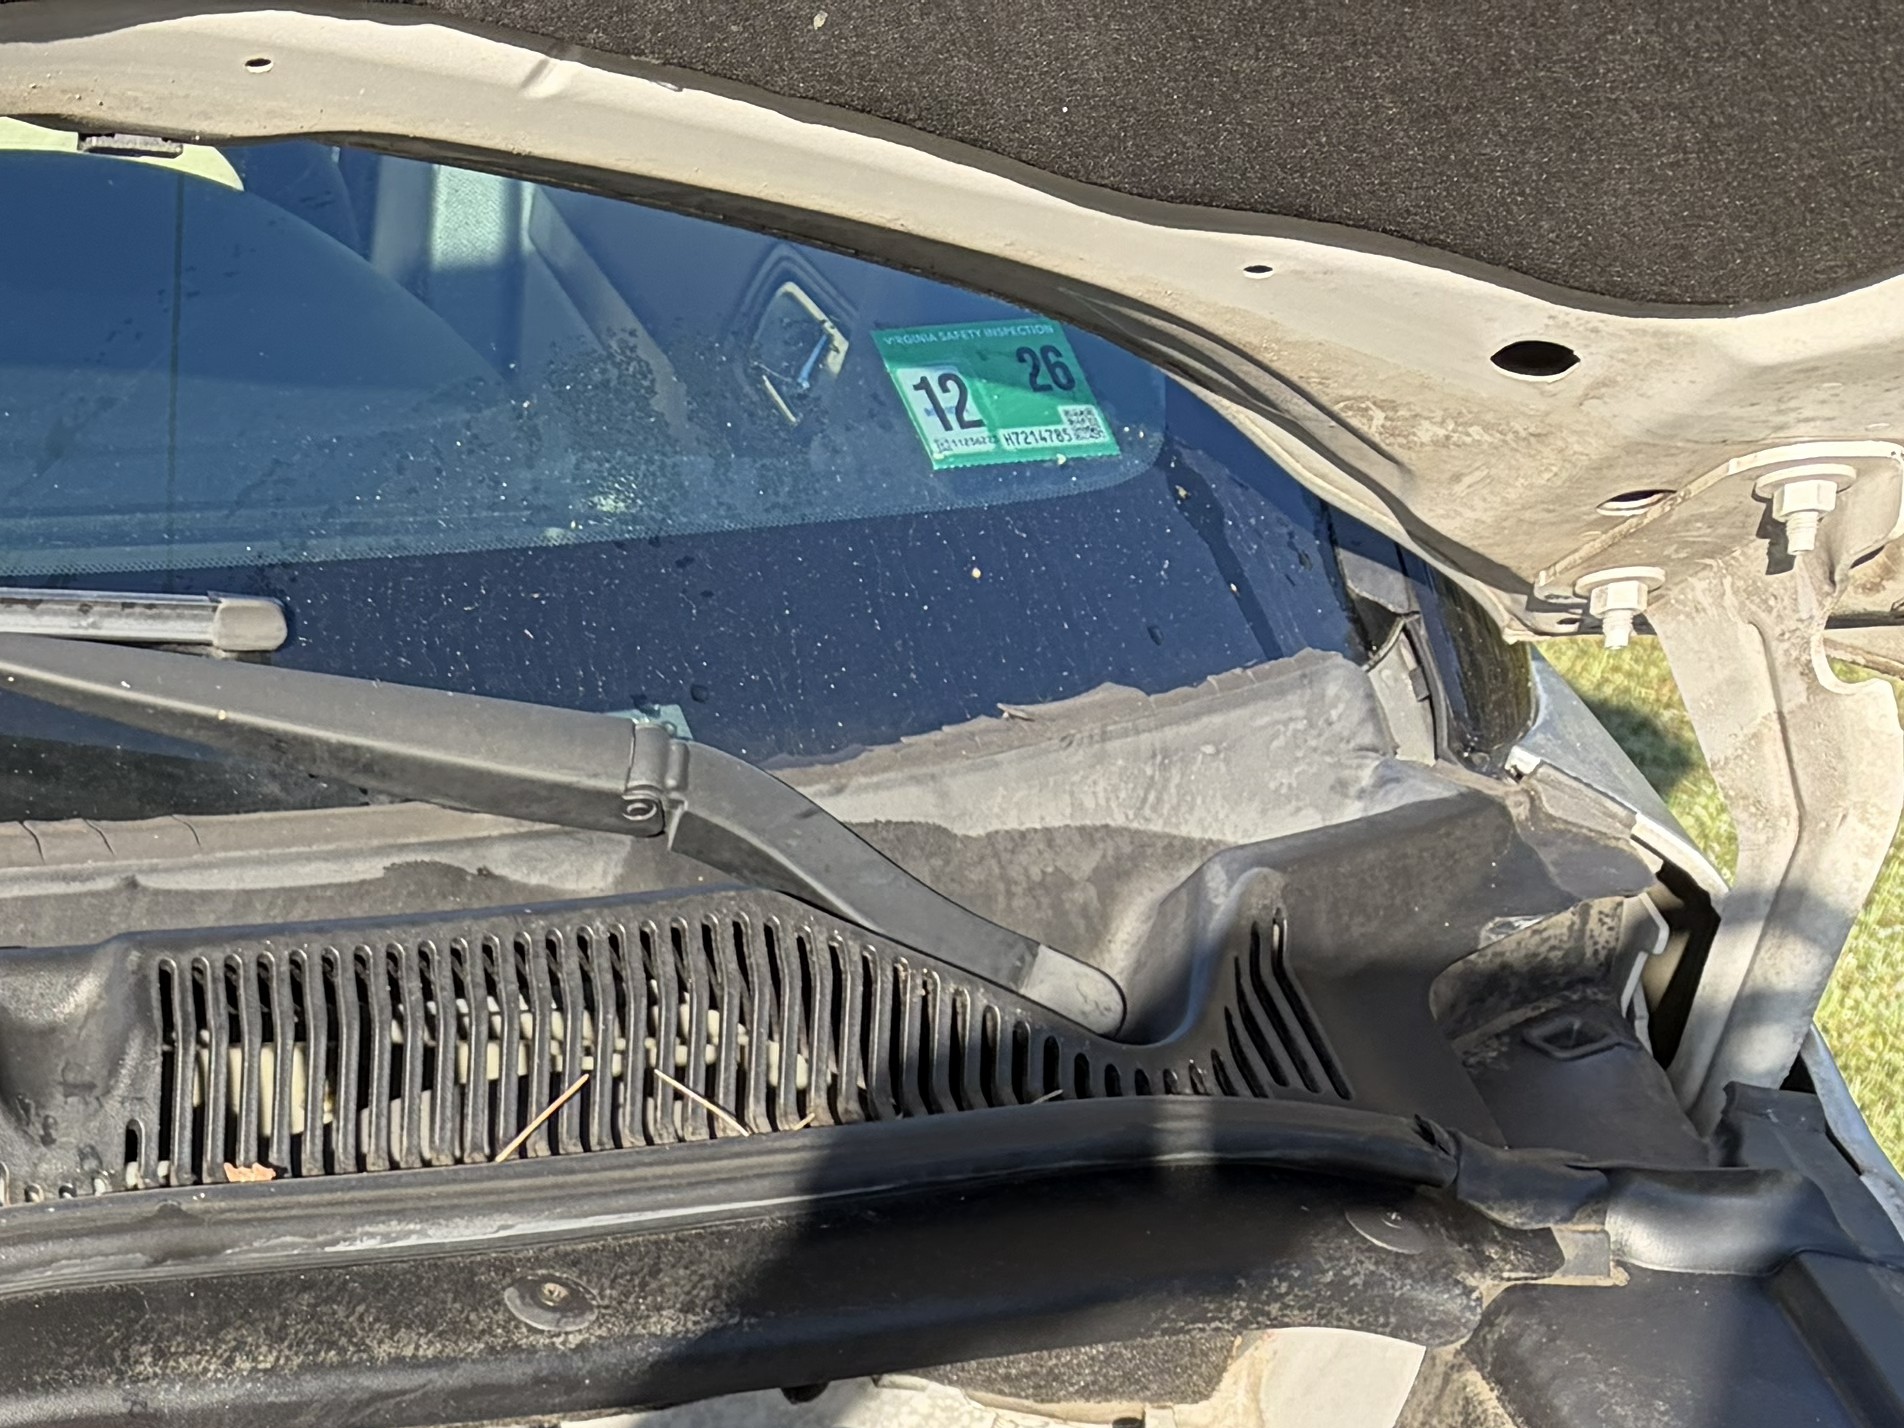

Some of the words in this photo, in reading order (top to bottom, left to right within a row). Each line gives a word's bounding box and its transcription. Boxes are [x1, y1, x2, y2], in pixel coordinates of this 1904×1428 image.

[883, 332, 937, 345] VIRGINIA
[941, 329, 981, 342] SAFETY
[985, 324, 1054, 338] INSPECTION
[1016, 344, 1076, 393] 26
[913, 373, 986, 432] 12
[1003, 428, 1072, 447] H7214785
